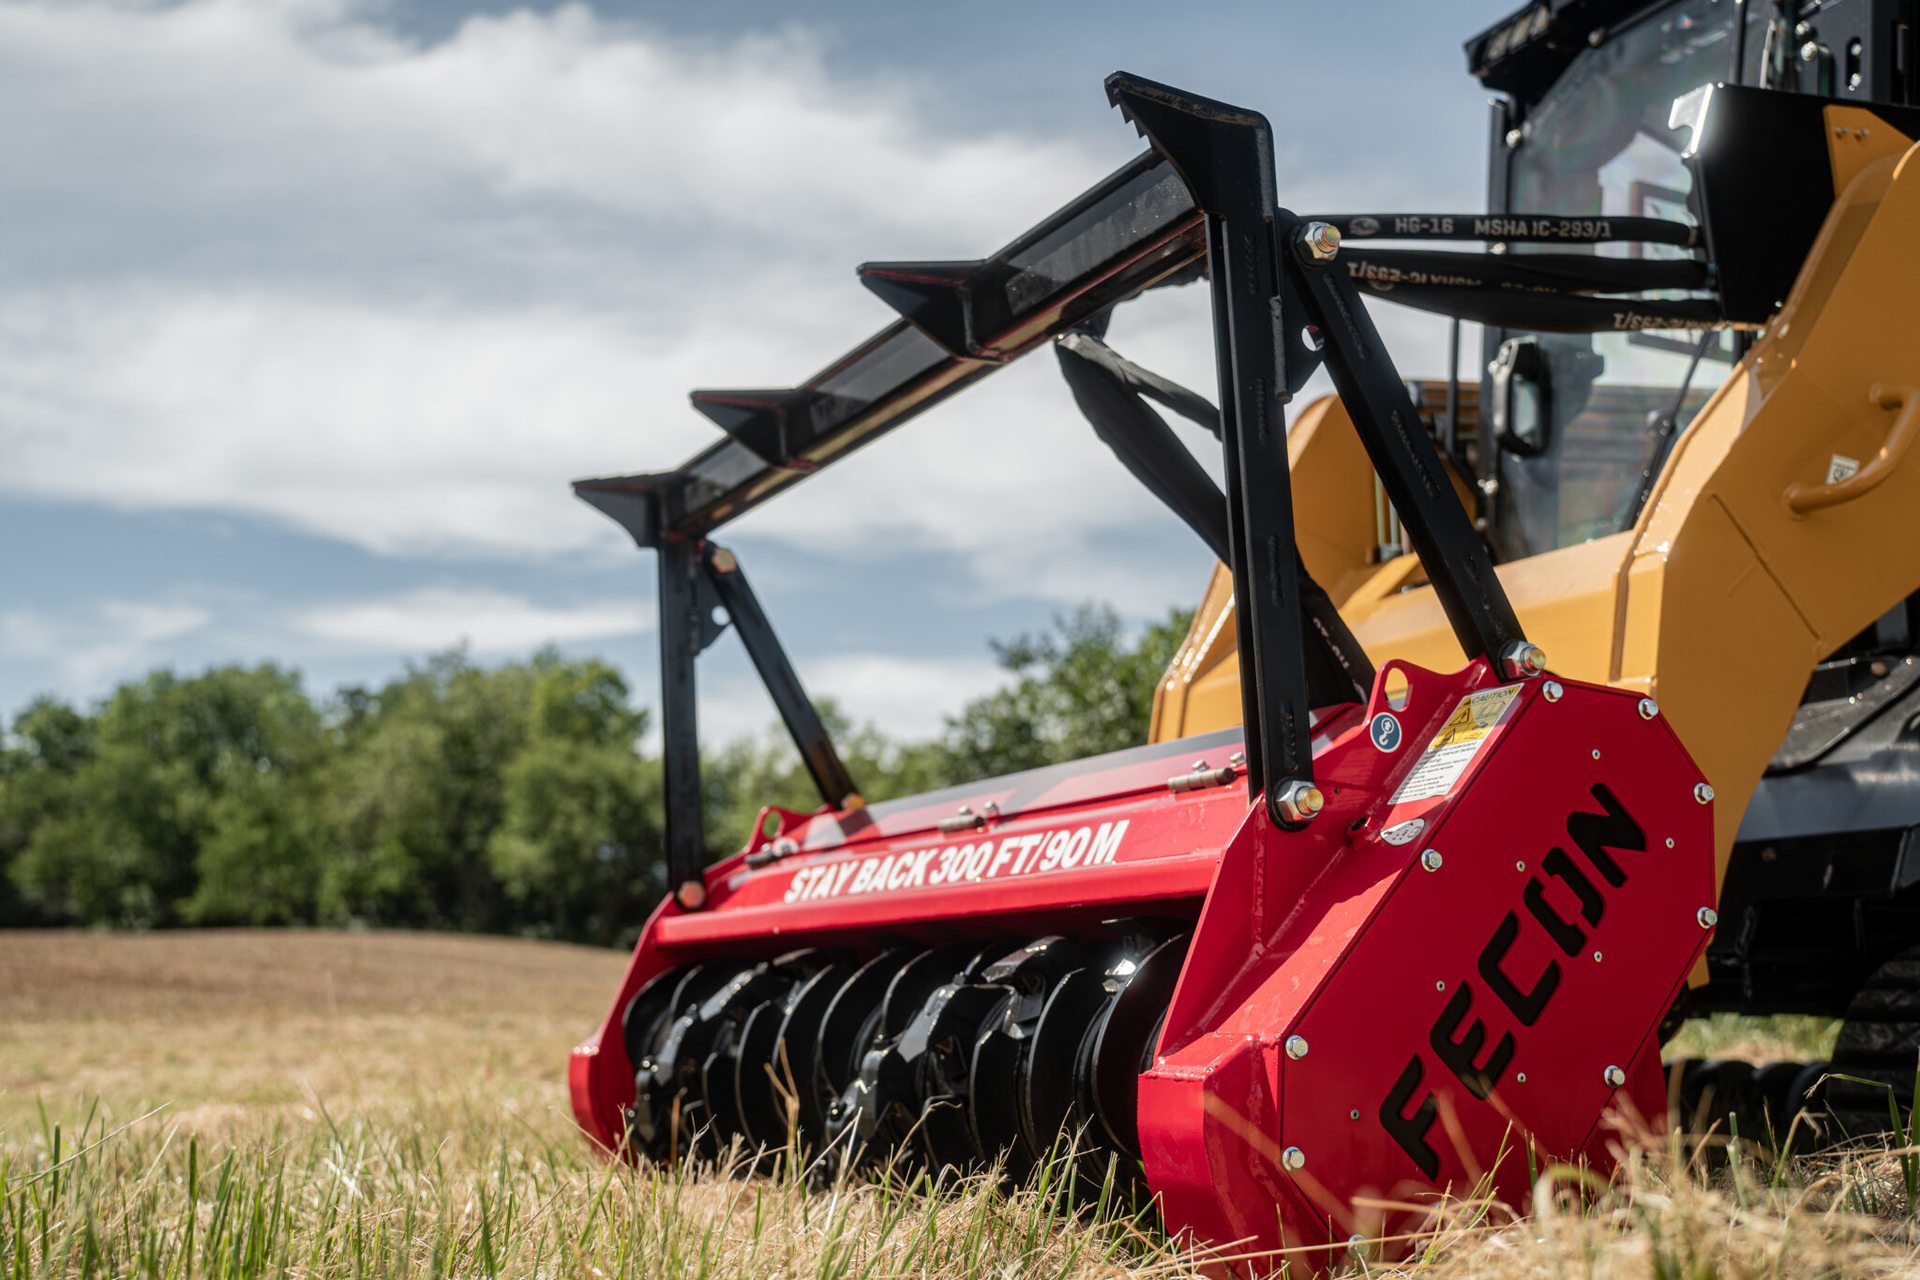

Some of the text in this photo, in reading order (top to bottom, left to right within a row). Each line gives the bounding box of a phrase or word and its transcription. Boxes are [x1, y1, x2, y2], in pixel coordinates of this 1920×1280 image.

[1395, 218, 1454, 235] HG-16
[1474, 219, 1527, 236] MSHA
[1471, 688, 1515, 704] CAUTION
[784, 862, 861, 904] STAY
[849, 848, 939, 894] BACK
[929, 840, 994, 885] 300
[1379, 782, 1647, 1183] FECON
